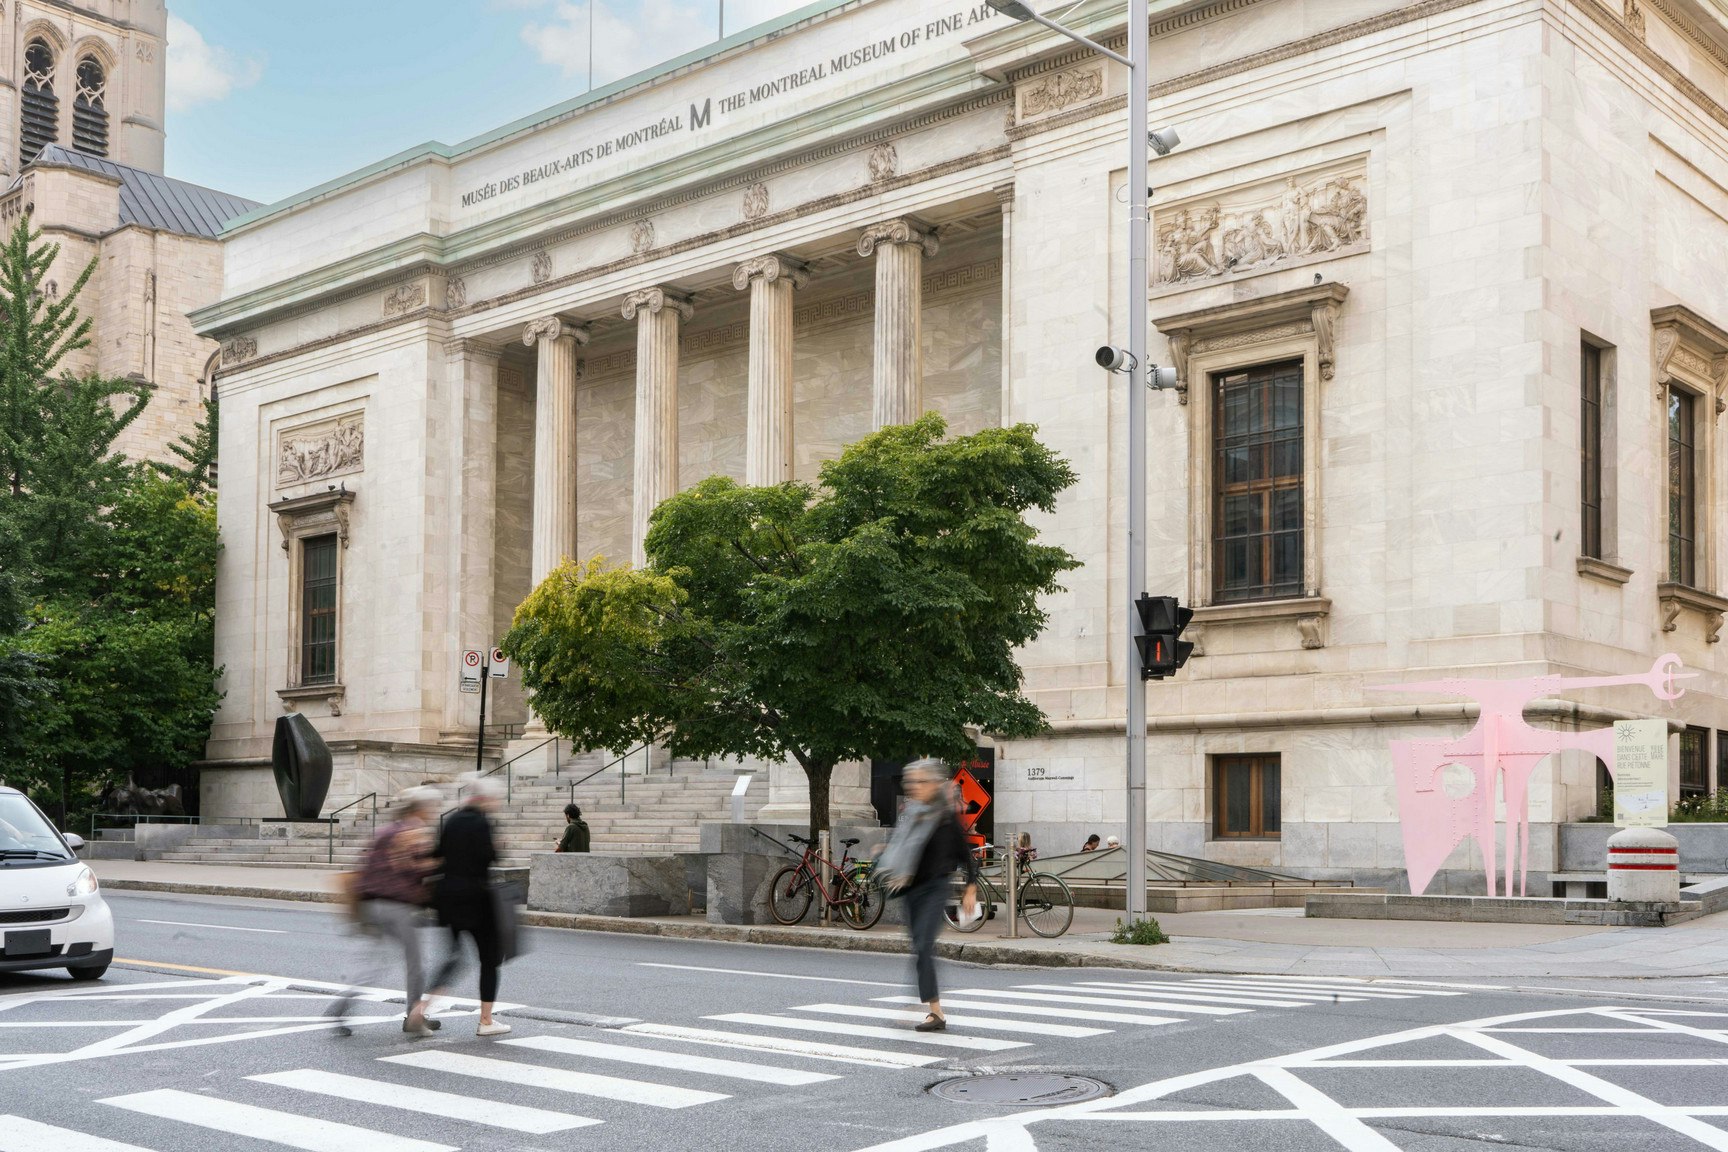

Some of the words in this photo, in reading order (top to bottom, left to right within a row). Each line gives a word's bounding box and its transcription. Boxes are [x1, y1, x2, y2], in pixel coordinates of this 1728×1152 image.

[718, 91, 746, 114] THE
[749, 63, 827, 104] MONTREAL
[830, 37, 896, 75] MUSEUM
[900, 27, 921, 49] OF
[925, 12, 963, 41] FINE
[690, 98, 711, 131] M
[461, 179, 497, 208] MUSÉE
[499, 174, 520, 194] DES
[522, 148, 594, 186] BEAUX-ARTS
[596, 140, 613, 160] DE
[615, 115, 683, 152] MONTRÉAL
[1027, 767, 1045, 777] 1379
